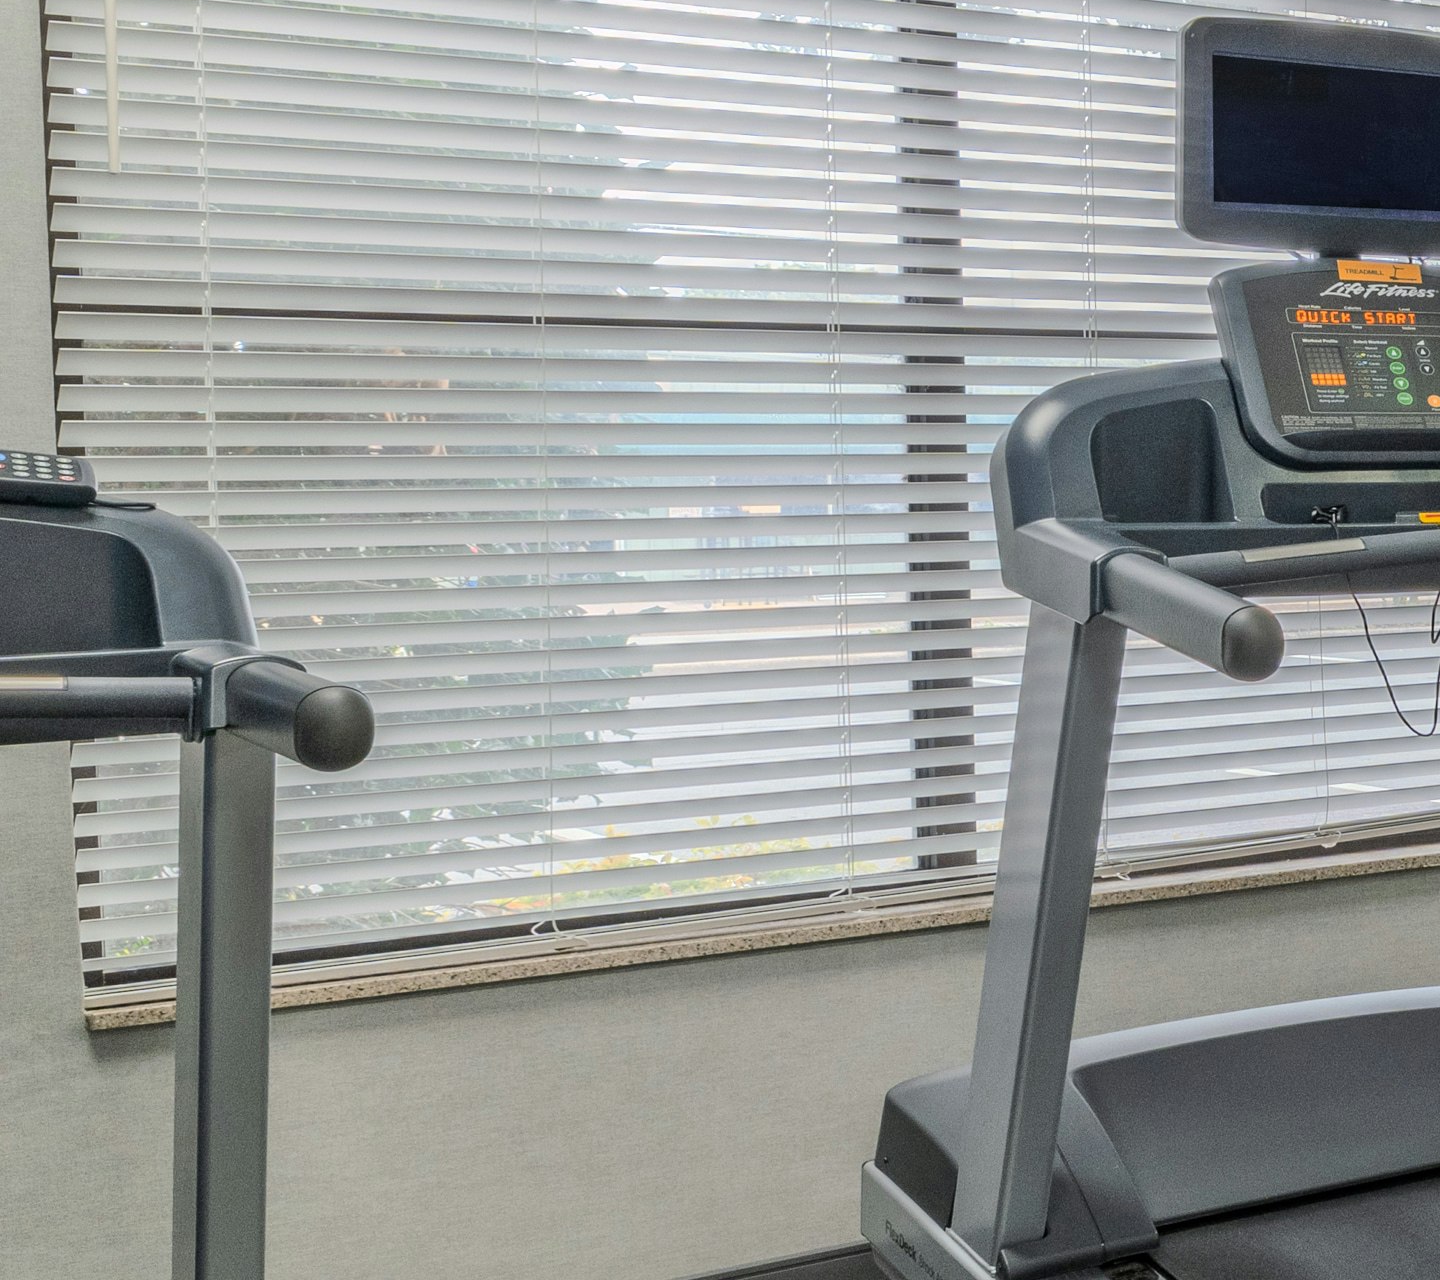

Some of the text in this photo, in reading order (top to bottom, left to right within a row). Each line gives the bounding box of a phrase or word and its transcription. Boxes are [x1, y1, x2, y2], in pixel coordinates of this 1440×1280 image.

[1345, 268, 1384, 276] TREADMILL
[1296, 309, 1416, 325] QUICK START
